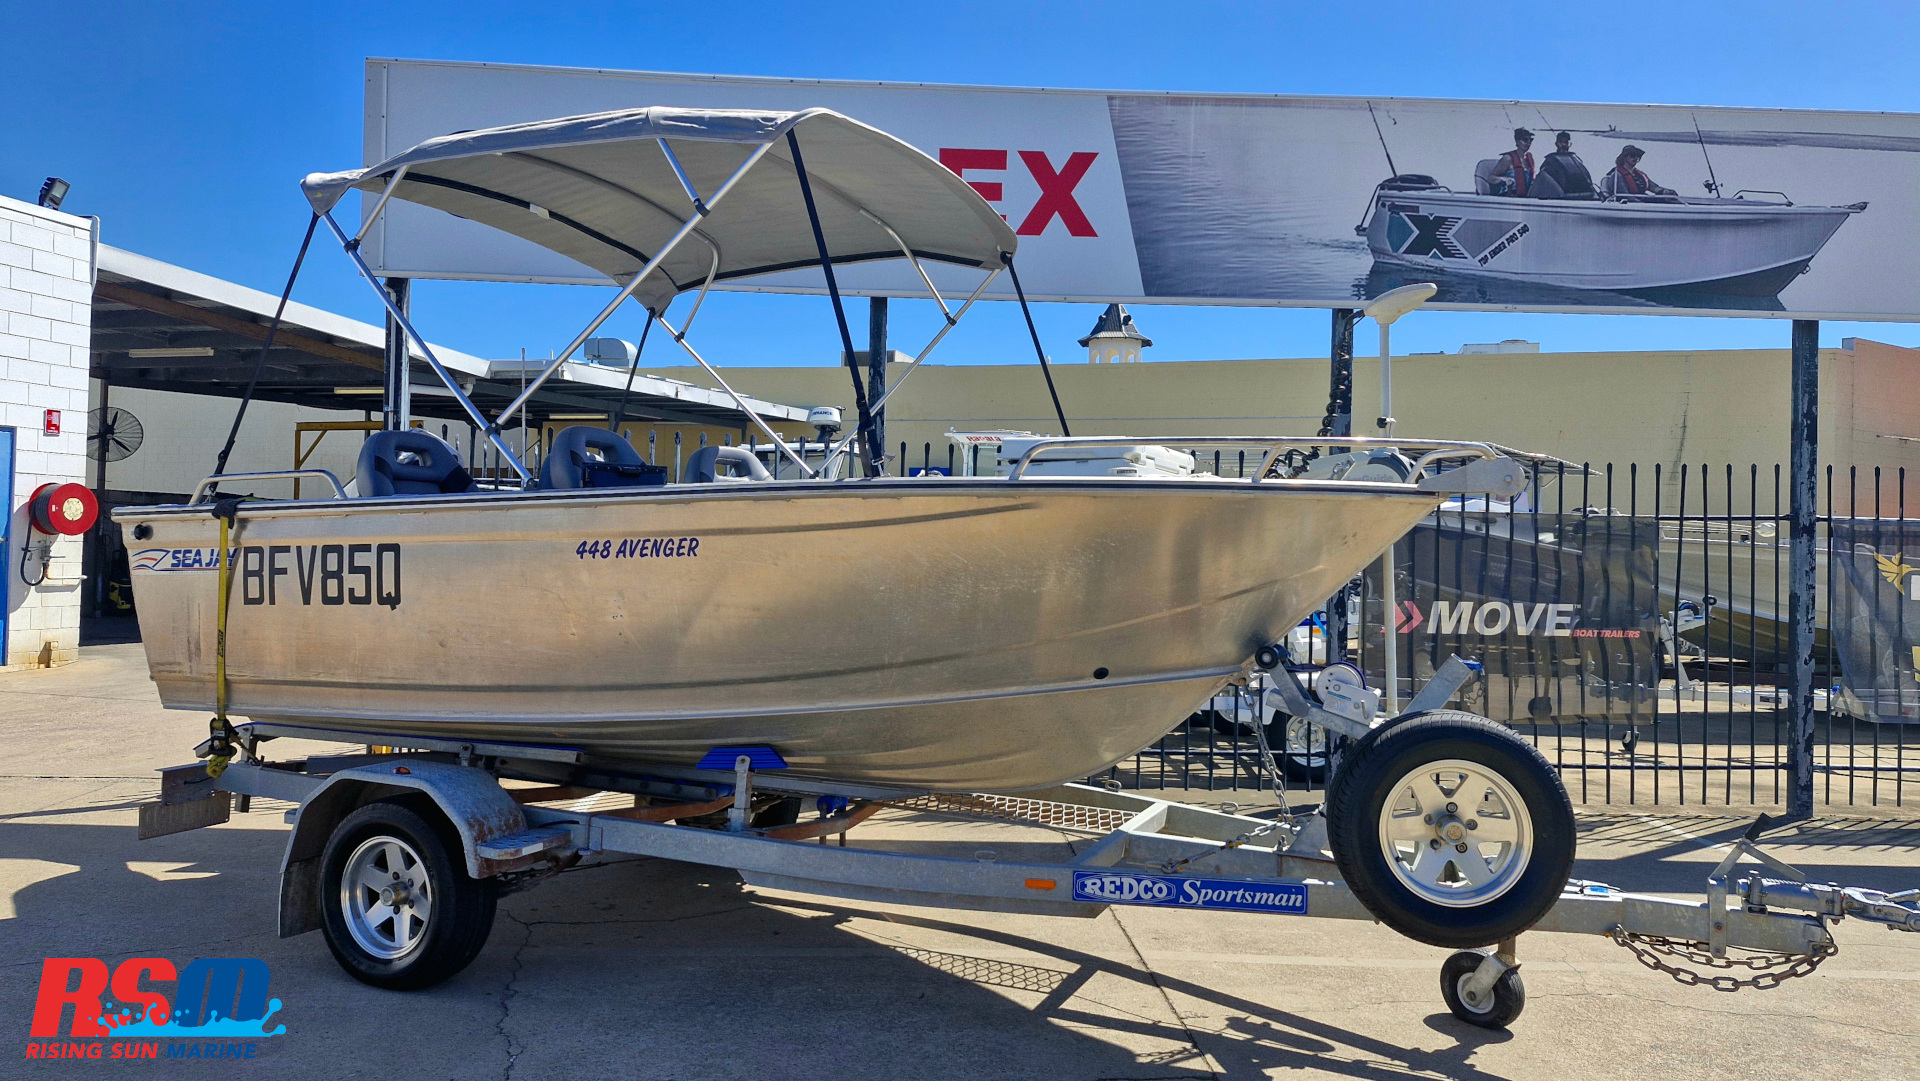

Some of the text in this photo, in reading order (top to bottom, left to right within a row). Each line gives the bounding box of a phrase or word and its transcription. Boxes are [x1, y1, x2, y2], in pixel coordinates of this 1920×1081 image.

[1477, 223, 1530, 268] TOP ENDER PRO 540
[171, 548, 203, 568] SEA
[576, 537, 700, 559] 448 AVENGER
[242, 543, 402, 611] BFV85Q
[1426, 600, 1574, 637] MOVE
[1573, 629, 1641, 639] BOAT TRAILERS
[1083, 876, 1303, 907] REDCO Sportsman
